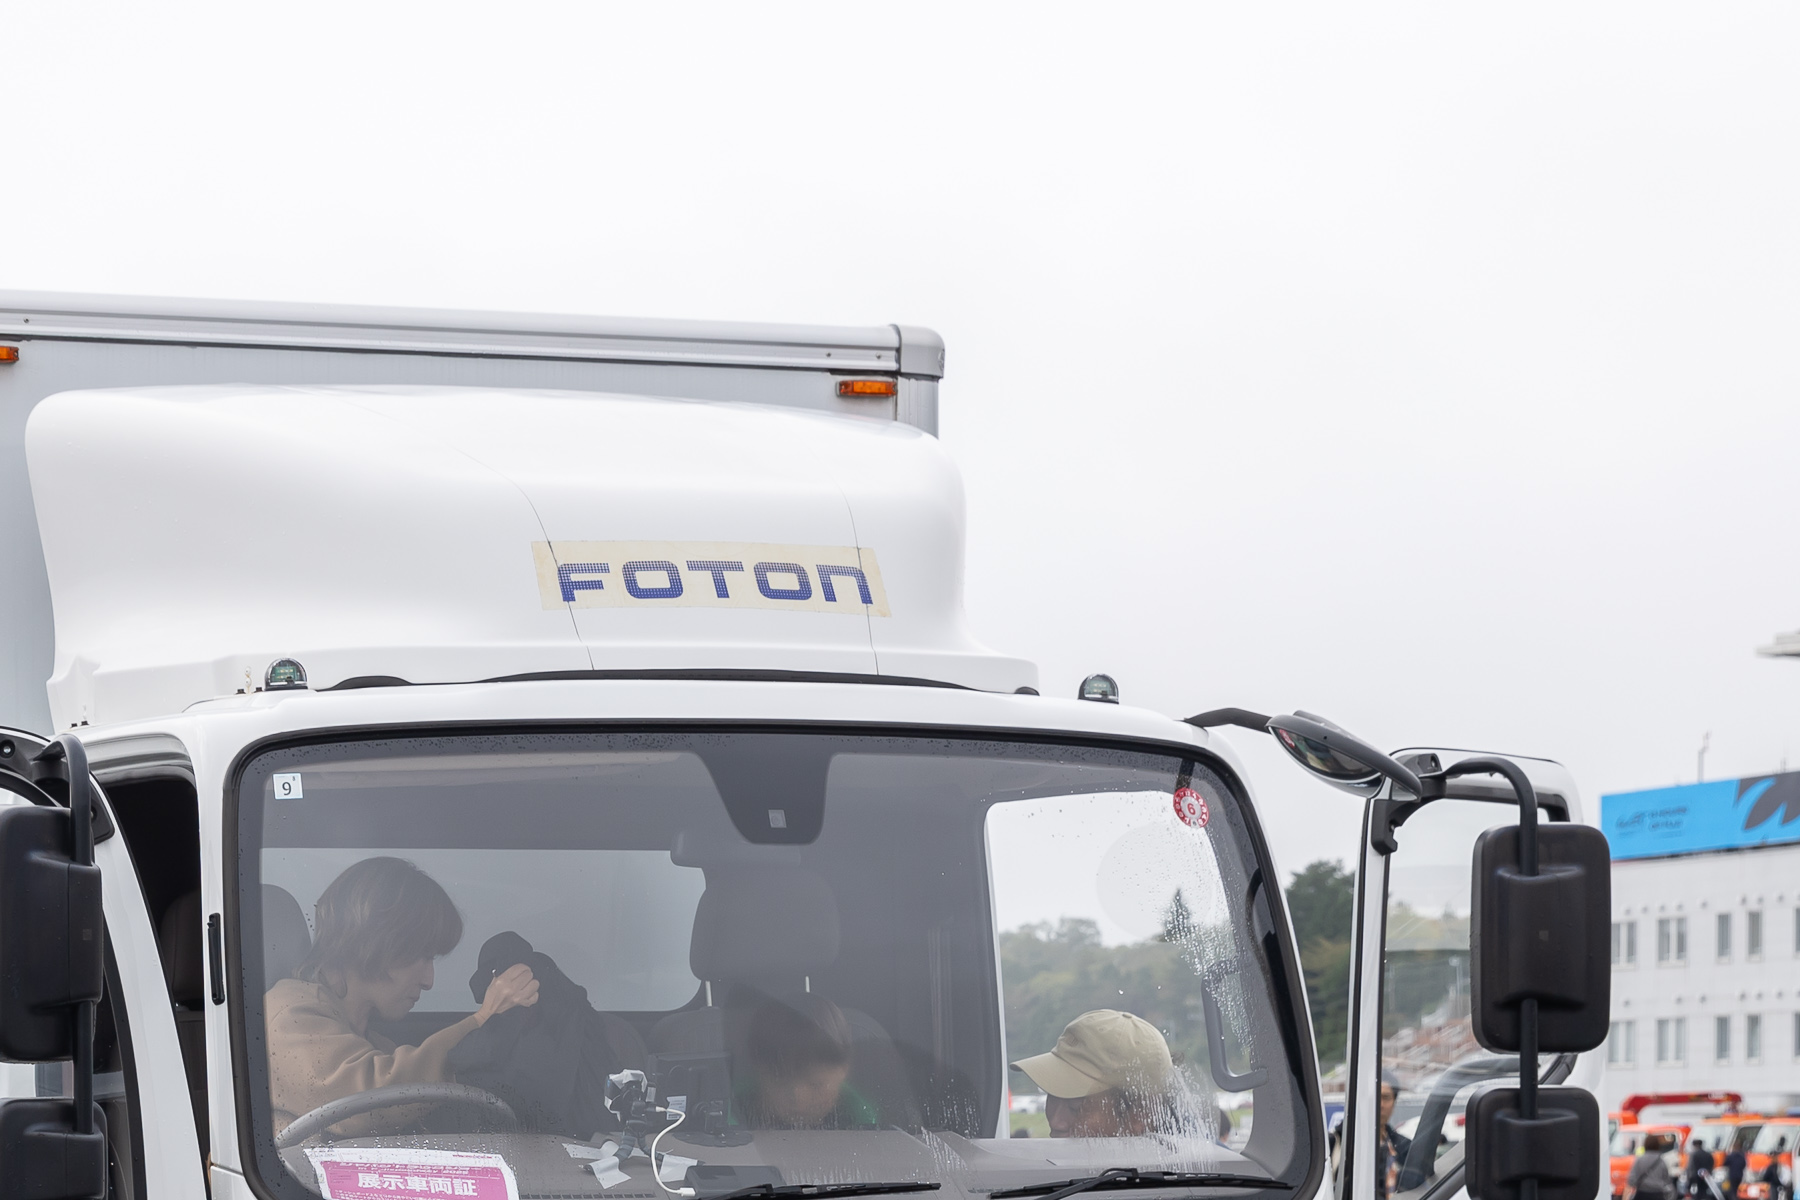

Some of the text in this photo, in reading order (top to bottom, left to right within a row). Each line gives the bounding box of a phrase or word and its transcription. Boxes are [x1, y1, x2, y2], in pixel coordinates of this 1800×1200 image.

[557, 559, 874, 605] FOTON
[281, 781, 292, 796] 9
[1187, 802, 1196, 816] 6
[357, 1172, 479, 1197] 展示車両証
